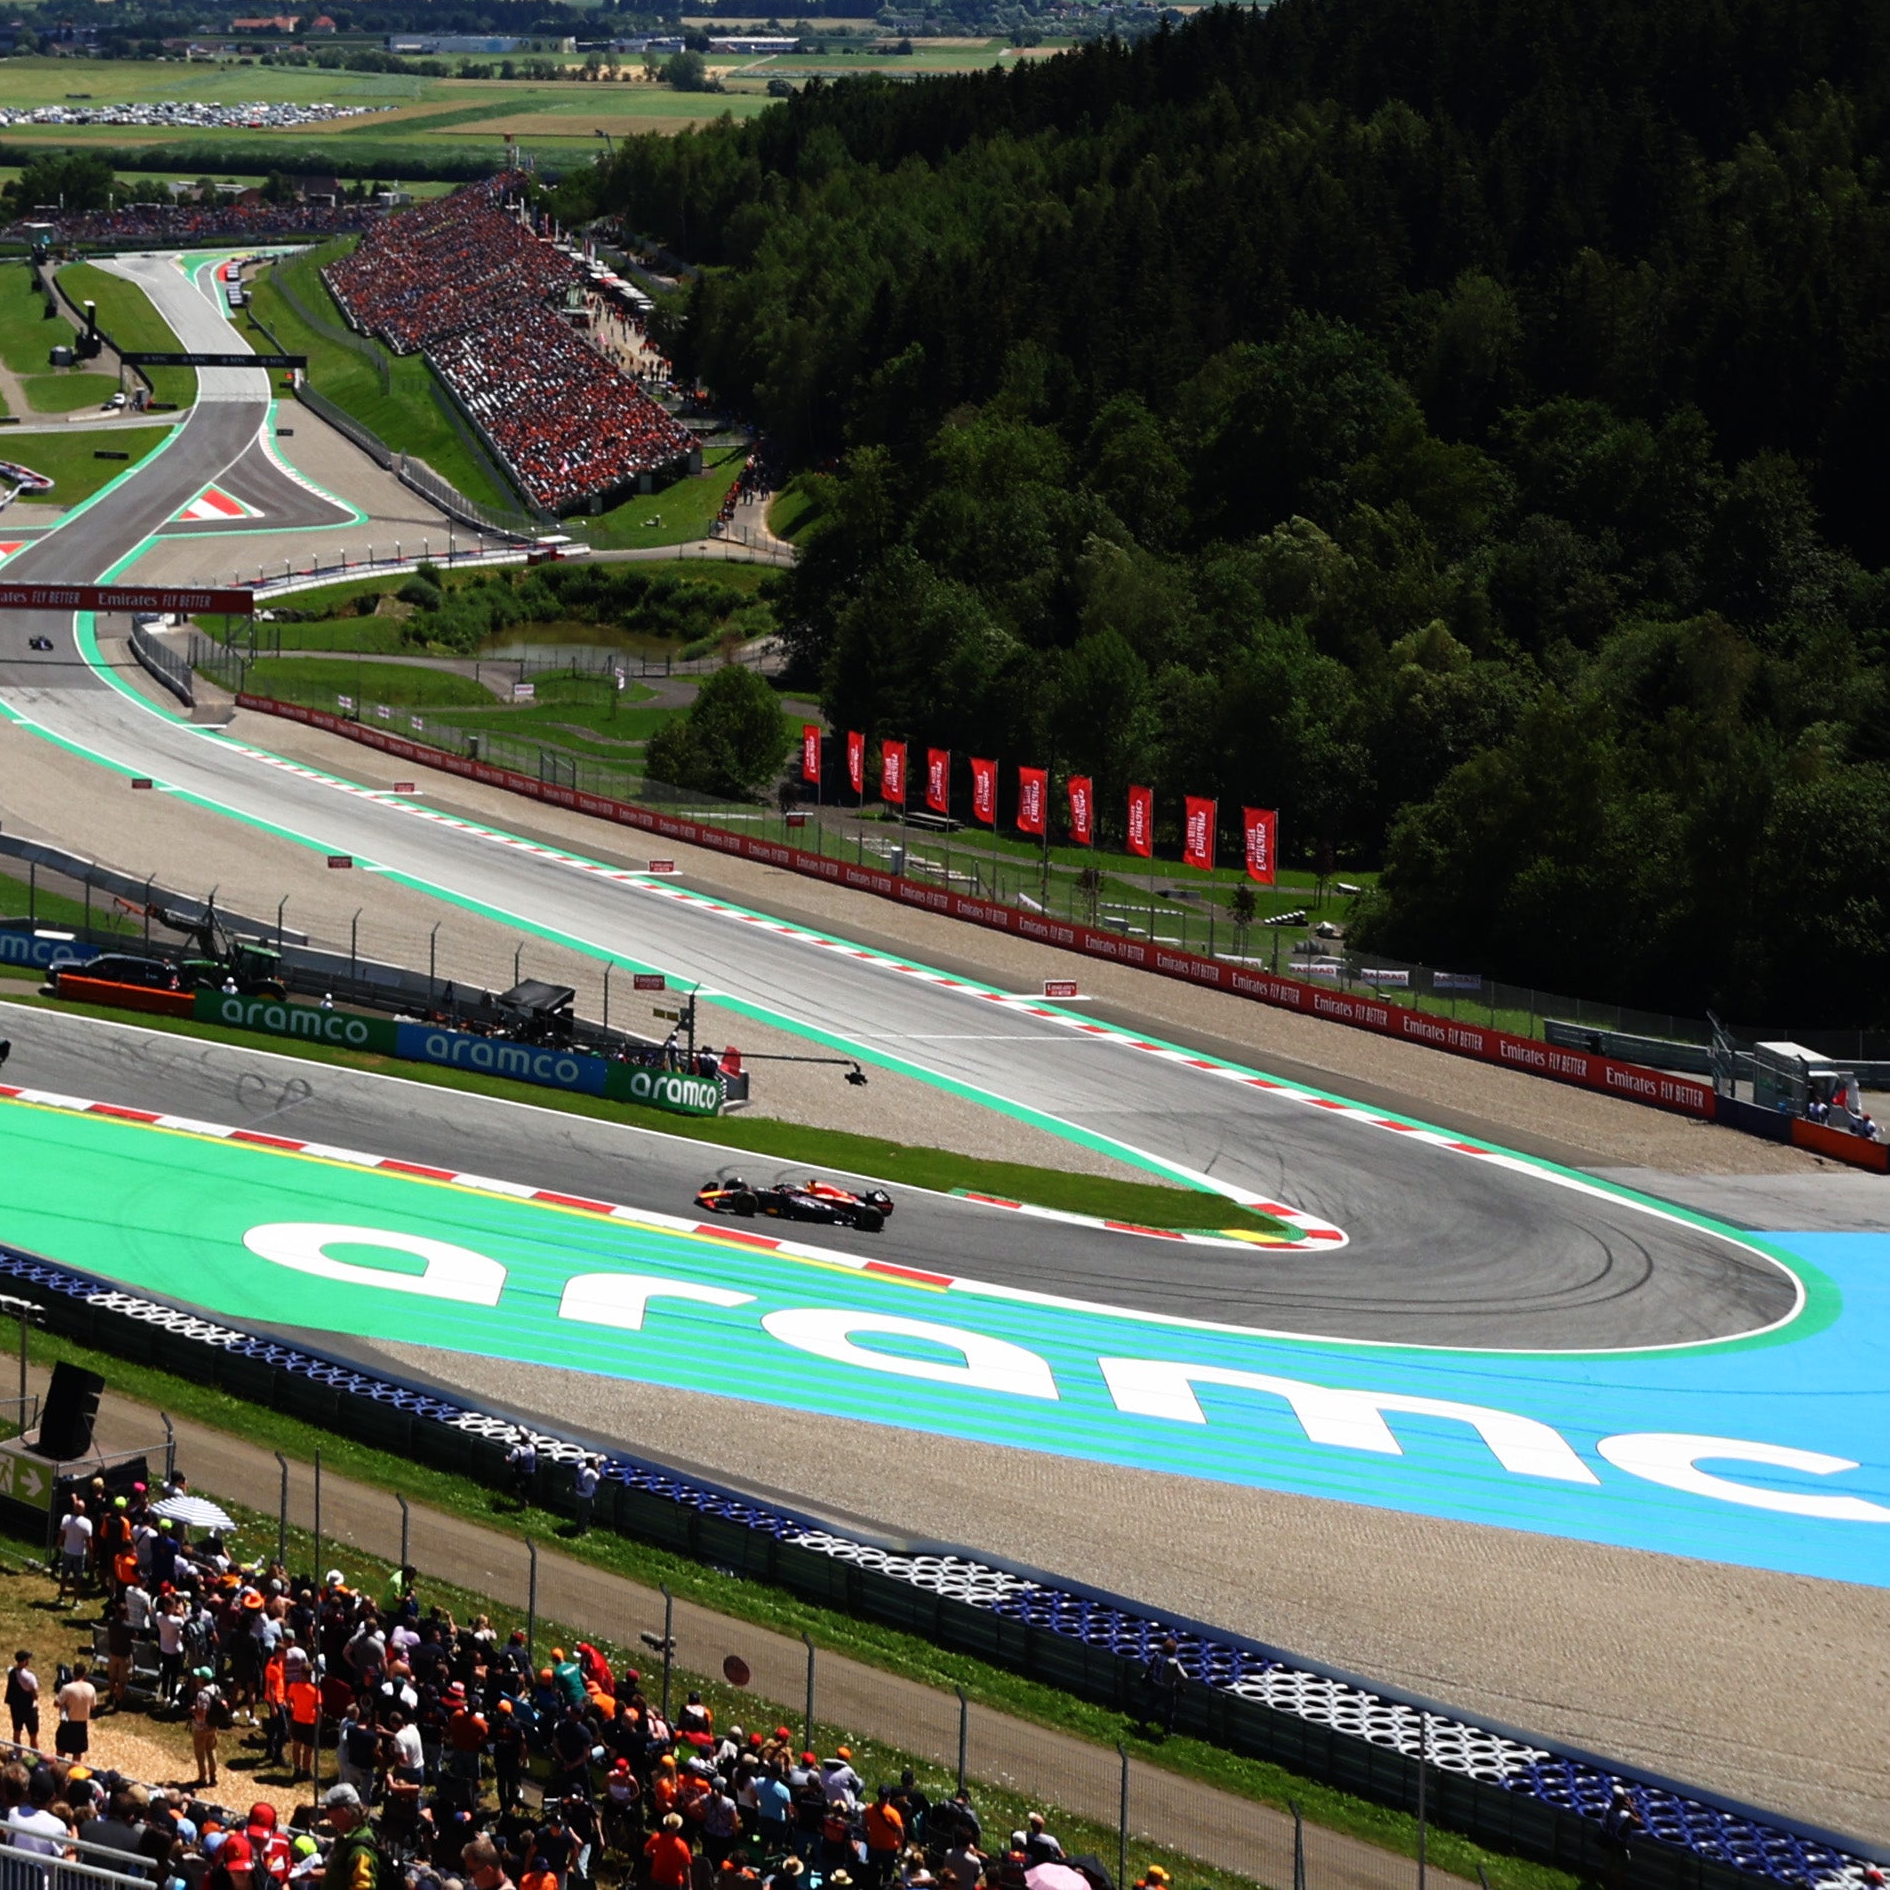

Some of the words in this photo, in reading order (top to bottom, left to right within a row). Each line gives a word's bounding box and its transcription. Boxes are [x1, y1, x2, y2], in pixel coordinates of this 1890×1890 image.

[31, 591, 47, 604] FLY
[49, 592, 81, 605] BETTER
[97, 592, 157, 607] Emirates
[162, 594, 178, 608] FLY
[180, 595, 212, 609] BETTER
[1085, 934, 1115, 955] Emirates
[1157, 951, 1189, 974] Emirates
[1232, 971, 1267, 995] Emirates
[221, 997, 369, 1044] aramco
[1314, 992, 1352, 1018] Emirates
[1355, 1002, 1366, 1020] FLY
[1366, 1005, 1387, 1027] BETTER
[1403, 1014, 1445, 1041] Emirates
[1448, 1026, 1459, 1045] FLY
[1459, 1029, 1483, 1051] BETTER
[426, 1033, 580, 1084] aramco
[1500, 1039, 1545, 1067] Emirates
[1549, 1052, 1561, 1070] FLY
[1561, 1055, 1587, 1077] BETTER
[631, 1071, 718, 1110] aramco
[1606, 1067, 1656, 1095] Emirates
[1660, 1081, 1674, 1100] FLY
[1675, 1085, 1704, 1108] BETTER
